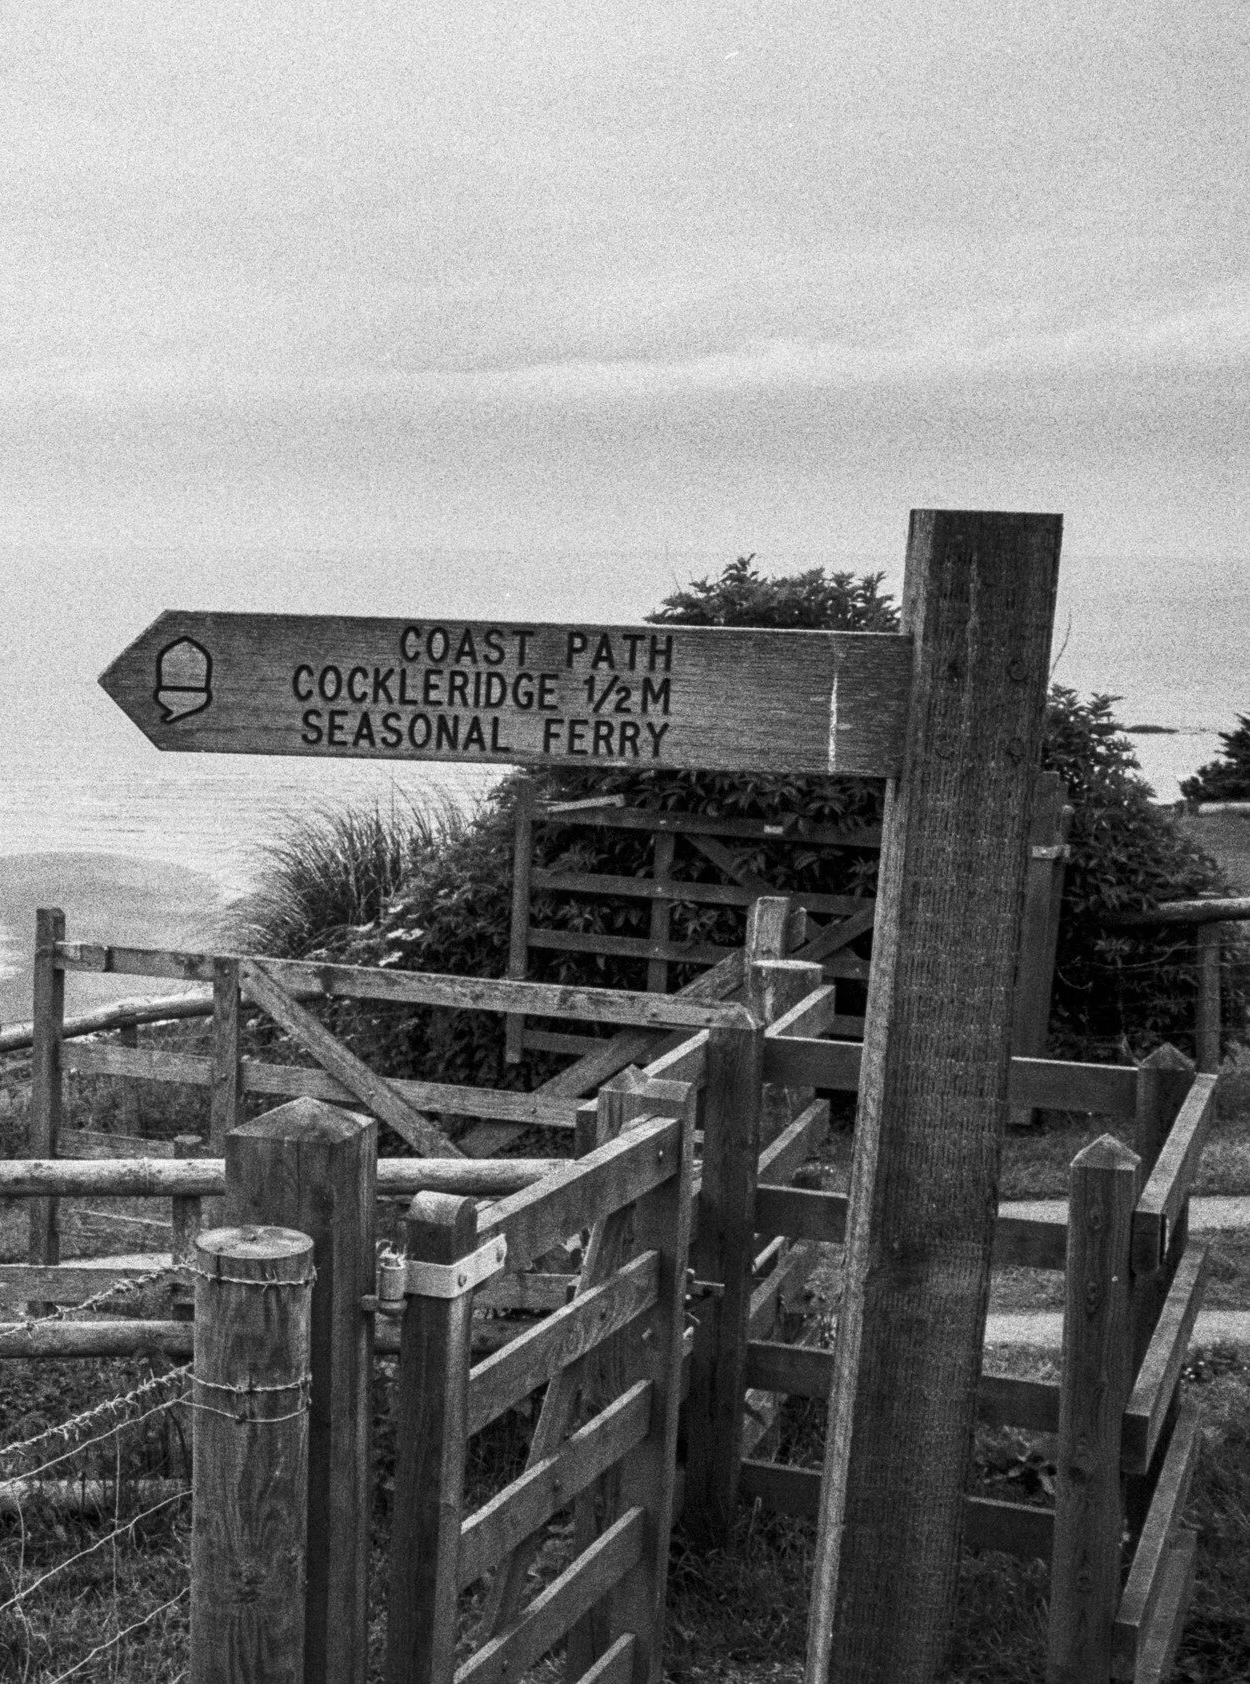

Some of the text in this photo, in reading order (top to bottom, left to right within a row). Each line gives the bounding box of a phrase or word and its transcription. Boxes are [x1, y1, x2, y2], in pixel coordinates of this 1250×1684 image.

[400, 626, 674, 672] COAST PATH
[291, 664, 559, 711] COCKLERIDGE
[301, 709, 670, 757] SEASONAL FERRY
